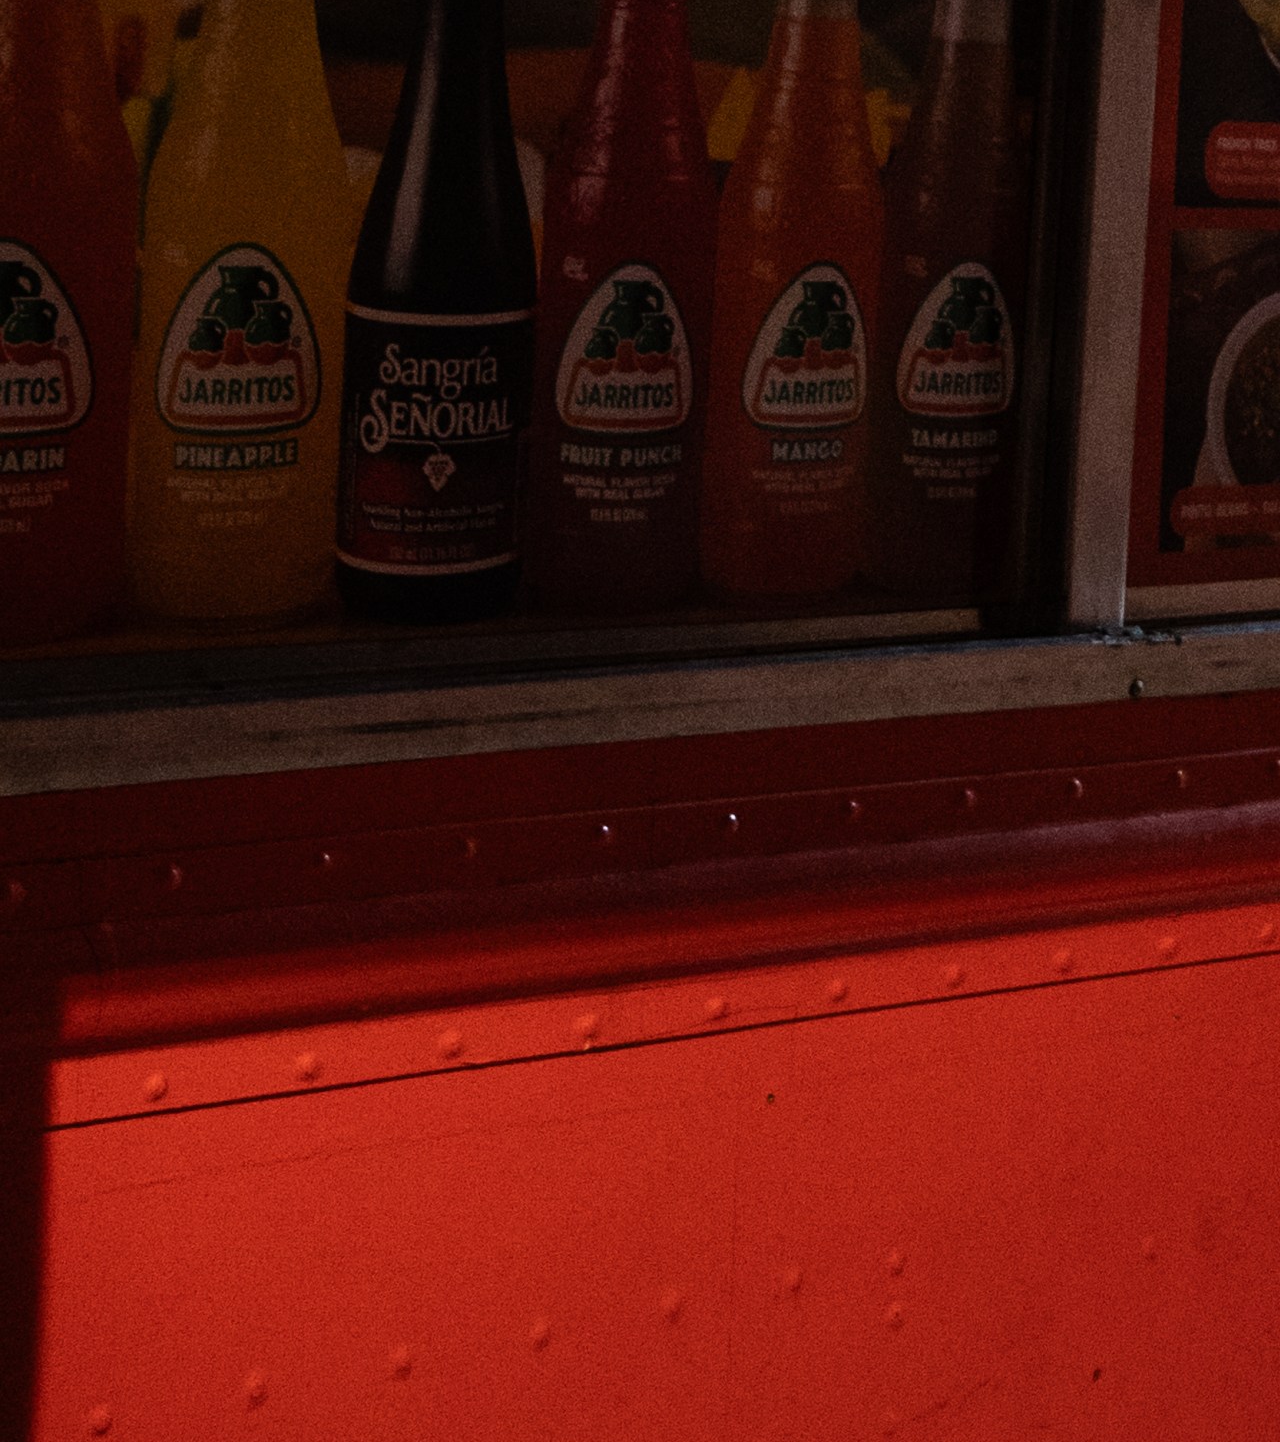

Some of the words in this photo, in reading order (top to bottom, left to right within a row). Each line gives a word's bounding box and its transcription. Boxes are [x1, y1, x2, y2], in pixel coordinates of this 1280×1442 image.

[378, 343, 499, 401] Sangría
[915, 370, 1002, 396] JARRITOS
[0, 378, 61, 406] ITOS
[179, 376, 296, 405] JARRITOS
[575, 383, 675, 408] JARRITOS
[764, 379, 854, 405] JARRITOS
[360, 388, 514, 455] SEÑORIAL
[175, 442, 298, 469] PINEAPPLE
[560, 442, 614, 467] FRUIT
[620, 443, 682, 467] PUNCH
[772, 439, 844, 462] MANGO
